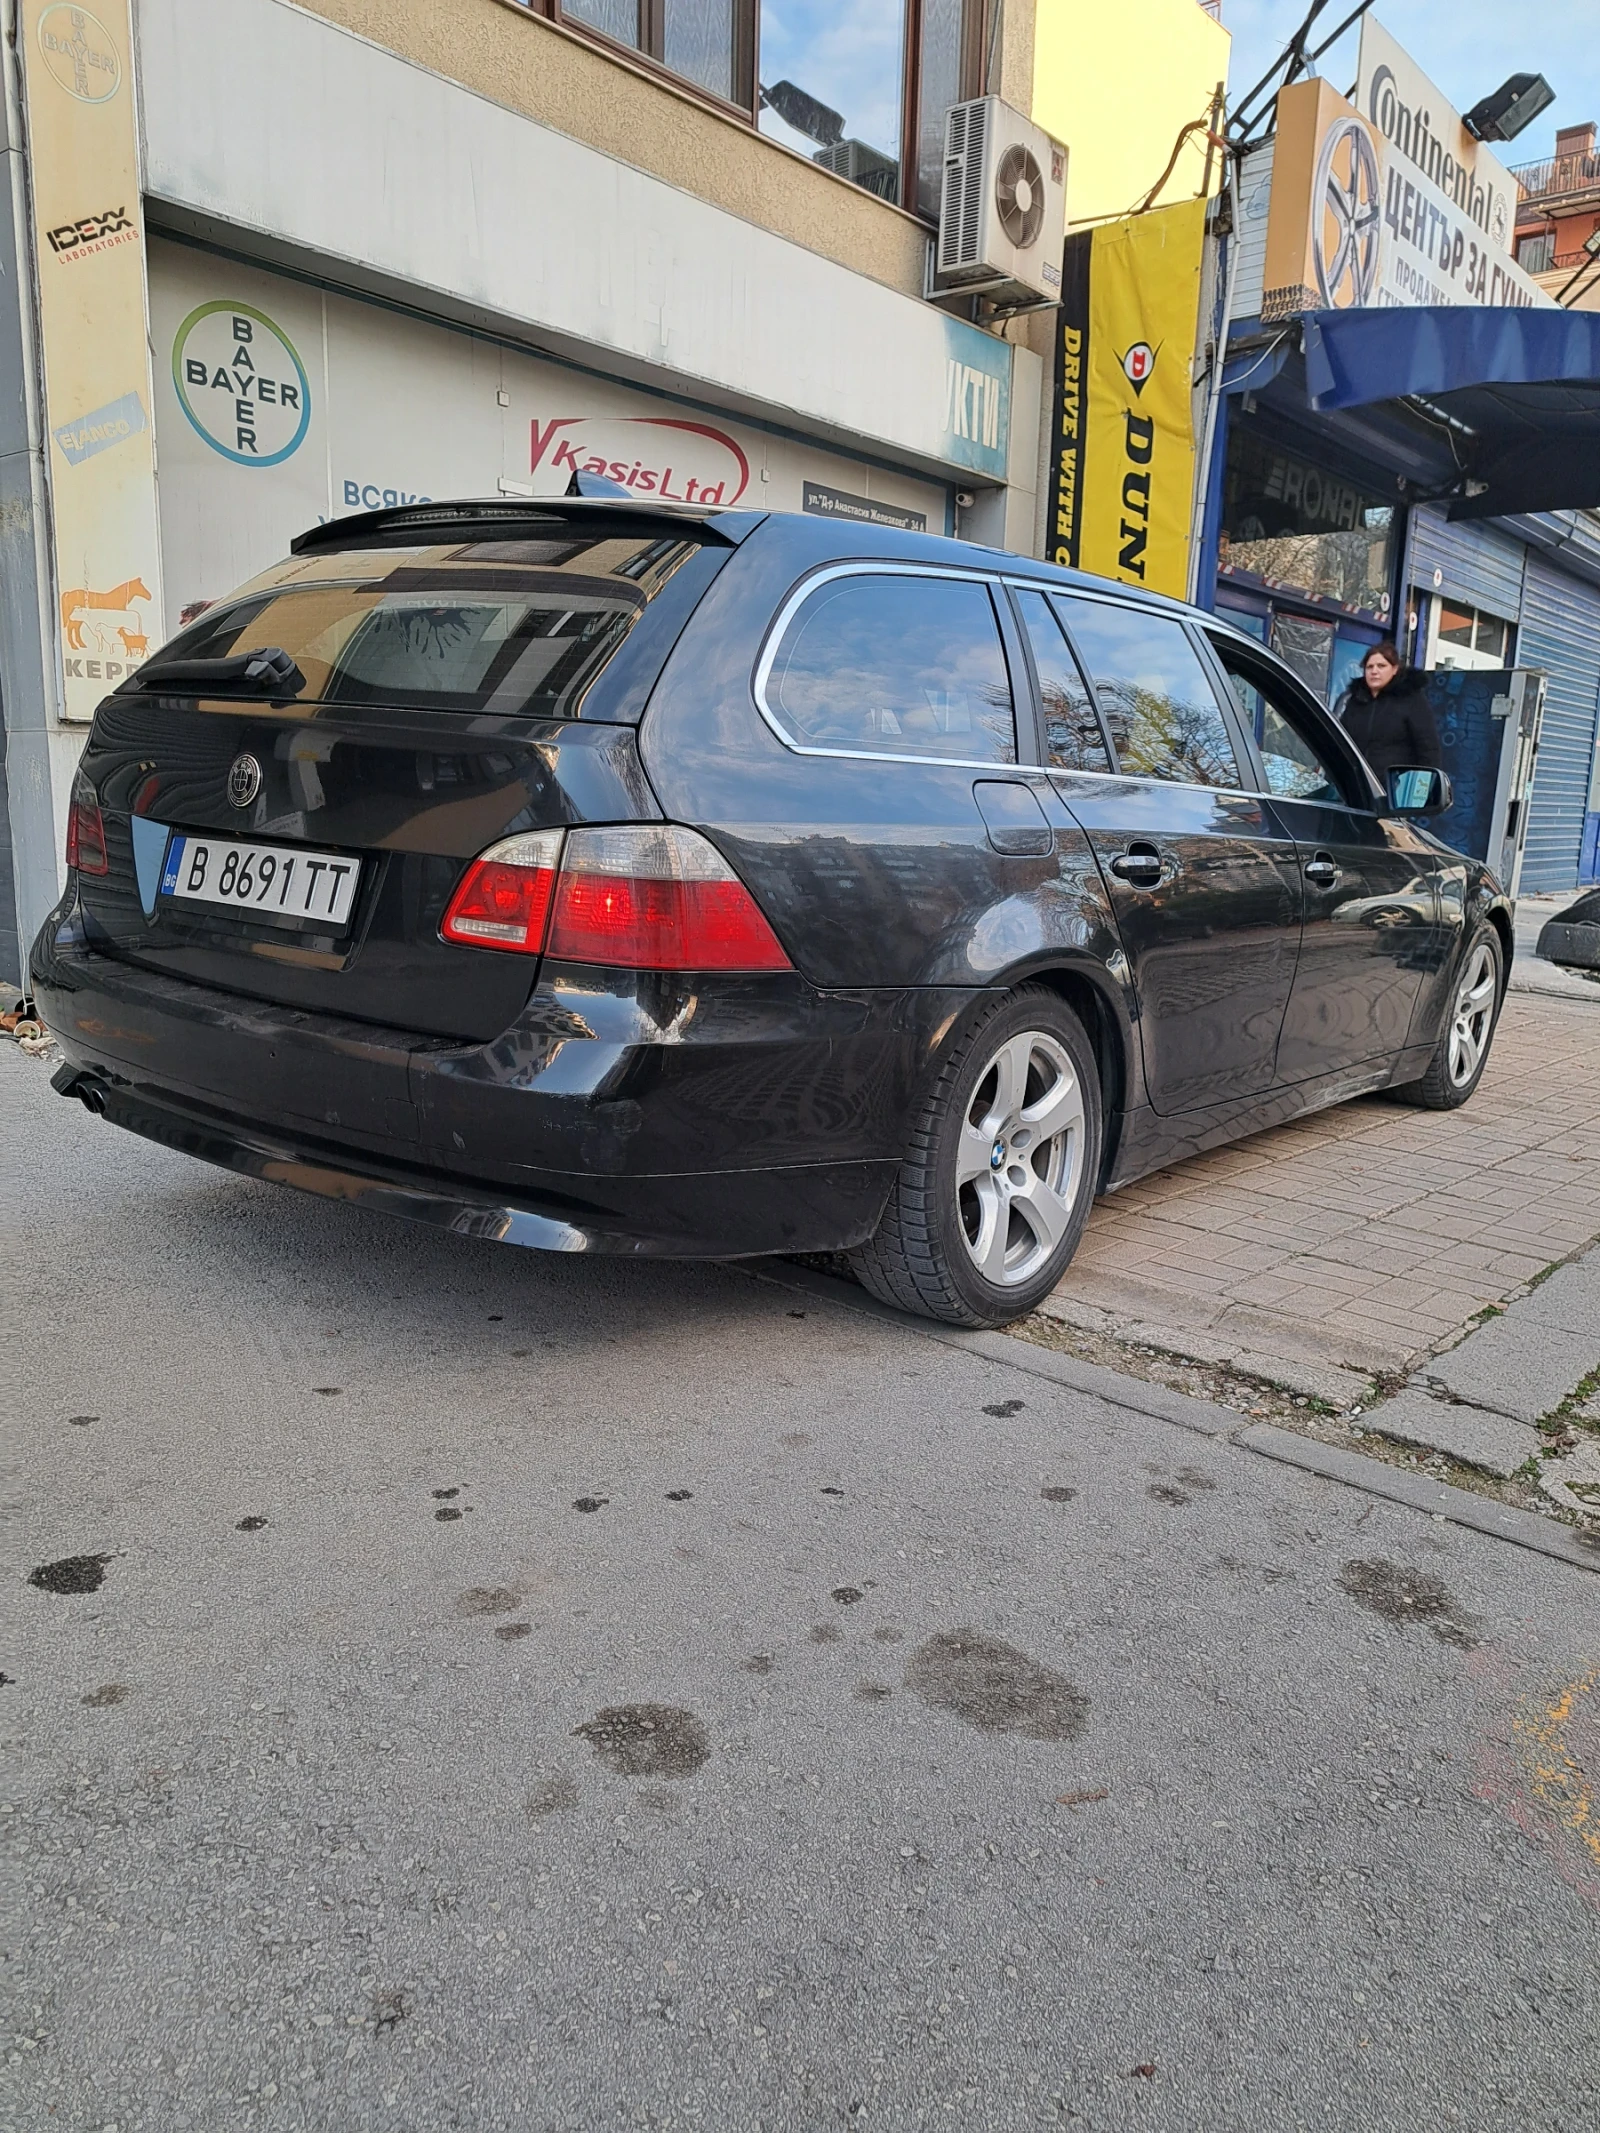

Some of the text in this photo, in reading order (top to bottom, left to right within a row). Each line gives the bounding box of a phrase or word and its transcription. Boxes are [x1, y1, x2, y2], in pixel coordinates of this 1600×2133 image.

[44, 32, 115, 75] BAYER
[71, 8, 89, 96] BAYER
[1370, 64, 1494, 236] Continental
[46, 206, 134, 253] IDEXX
[58, 230, 140, 265] LABORATORIES
[1384, 165, 1465, 280] ЦЕНТЪР
[1465, 241, 1488, 305] ЗА
[186, 358, 300, 411] BAYER
[231, 316, 259, 454] BAYER
[1062, 325, 1082, 440] DRIVE
[344, 480, 433, 510] ВСЯК
[1057, 447, 1077, 540] WITH
[1118, 406, 1154, 583] DUN
[164, 873, 177, 888] BG
[187, 846, 350, 914] B 8691 TT
